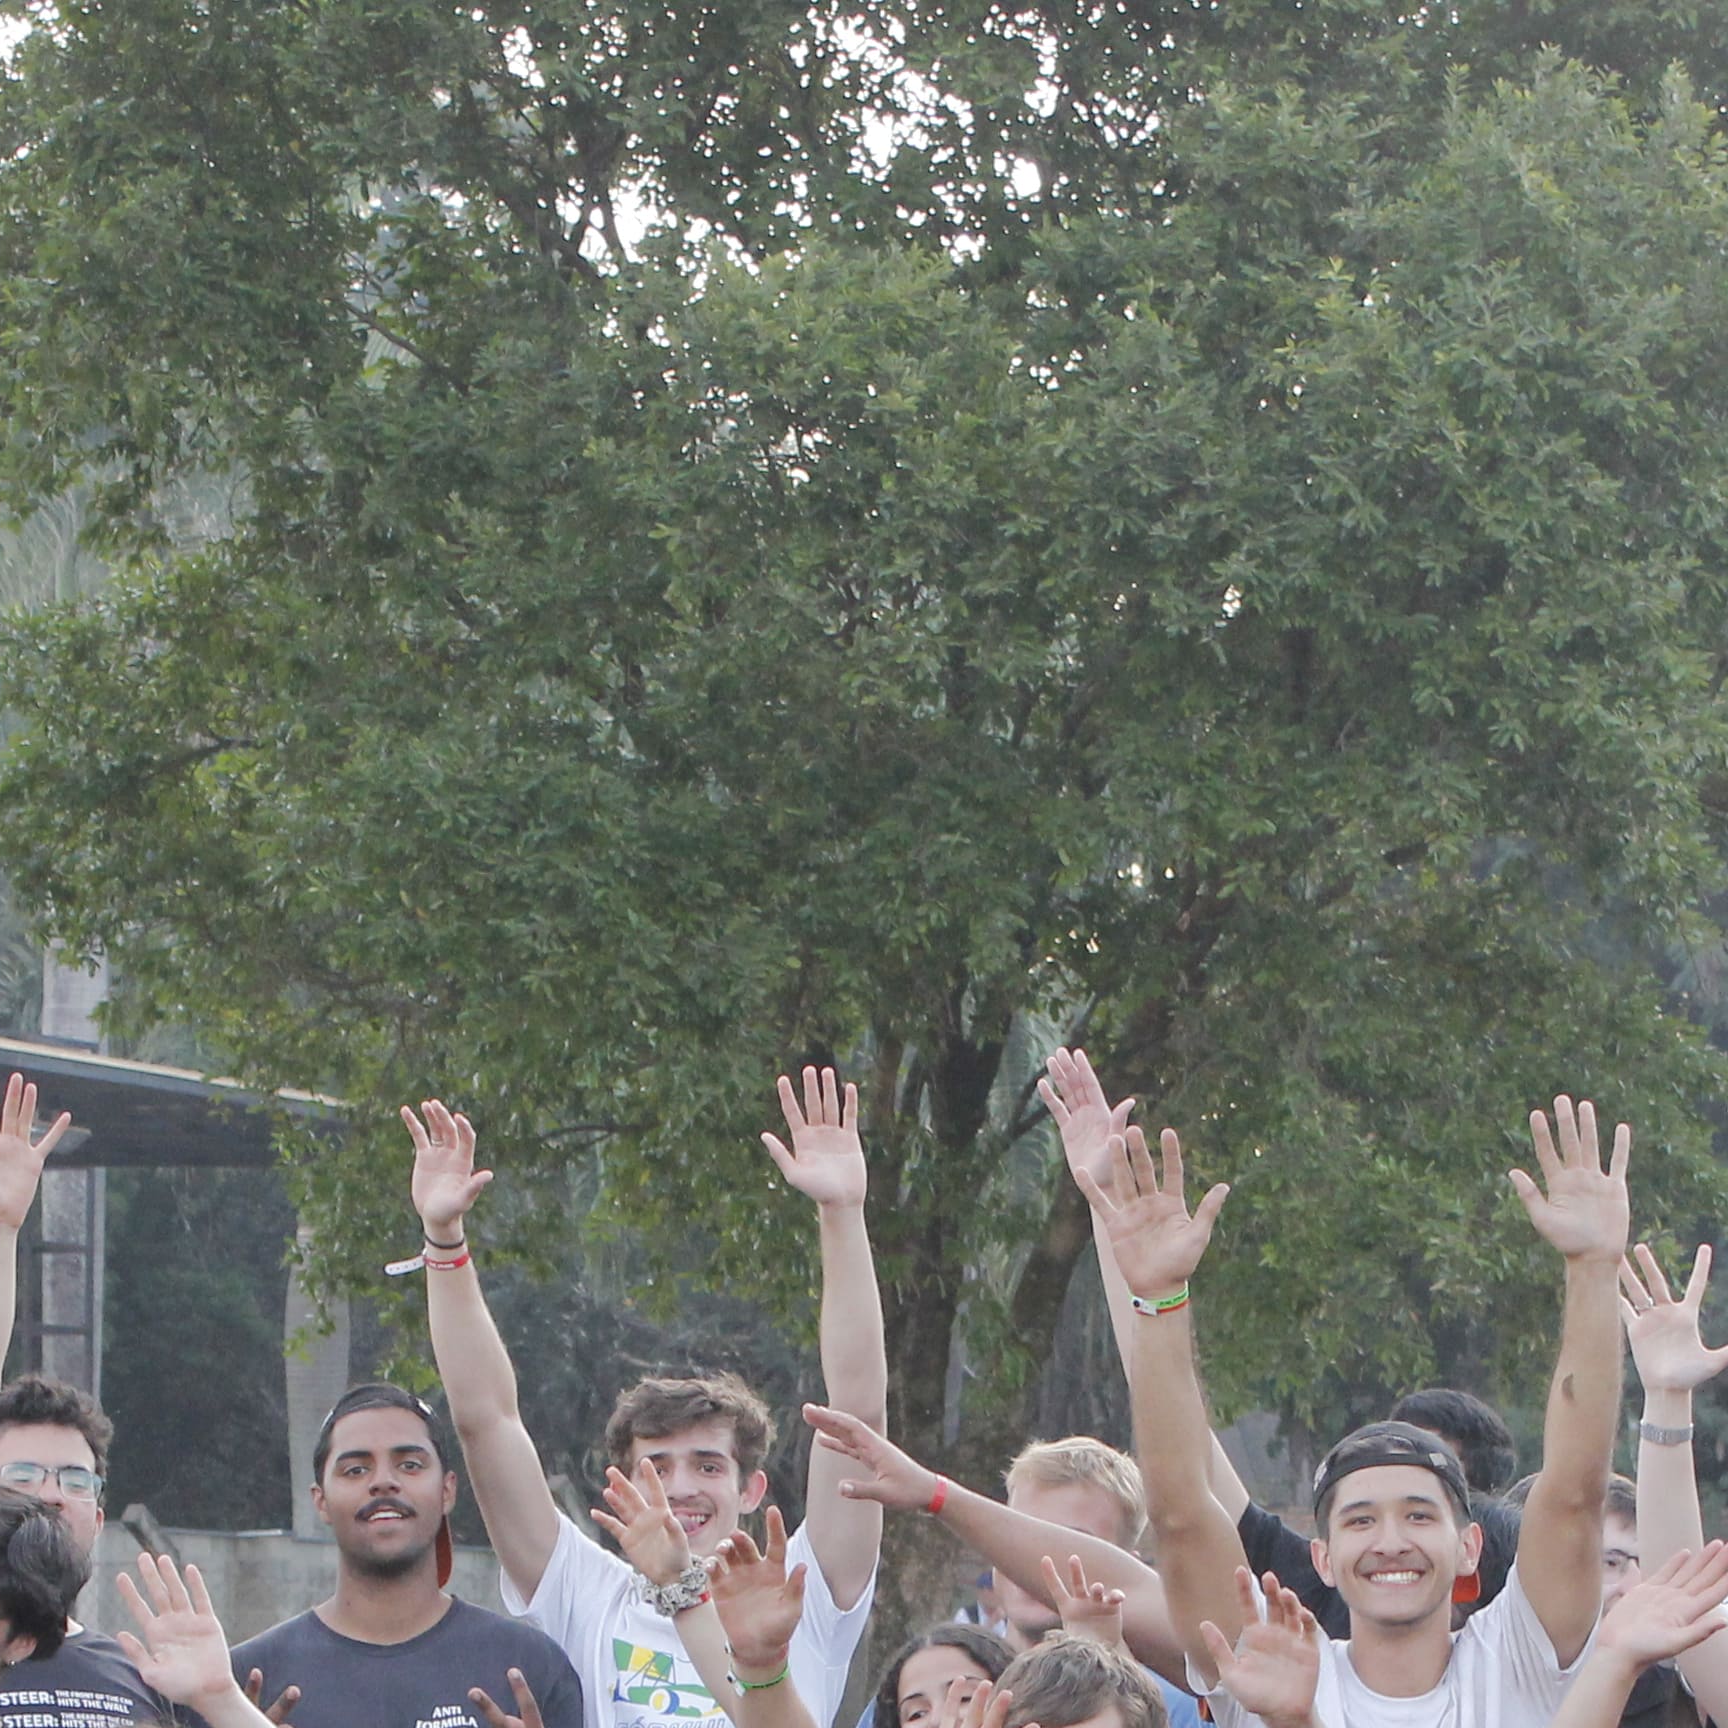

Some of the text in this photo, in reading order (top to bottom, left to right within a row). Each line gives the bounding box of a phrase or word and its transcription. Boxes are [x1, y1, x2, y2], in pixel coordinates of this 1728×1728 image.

[57, 1698, 130, 1715] HITS THE WALL
[432, 1706, 462, 1719] ANTI
[62, 1719, 85, 1728] HITS
